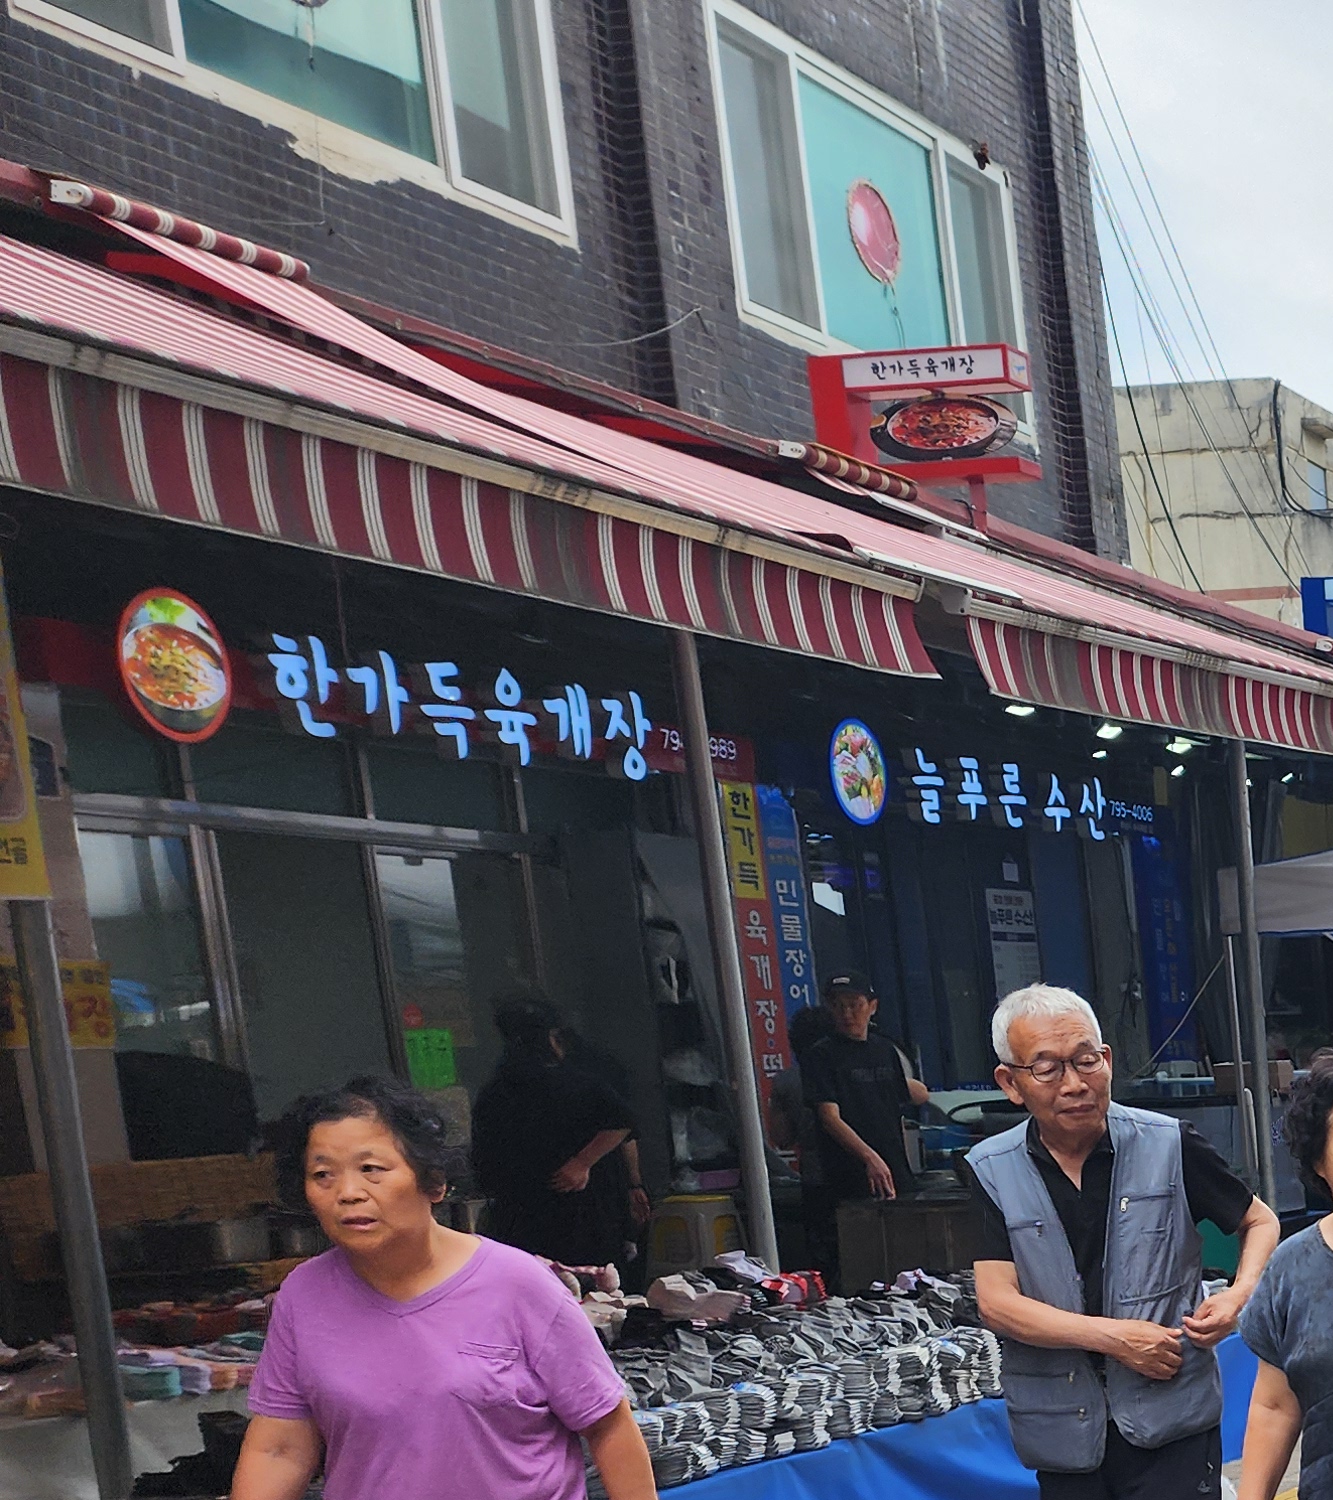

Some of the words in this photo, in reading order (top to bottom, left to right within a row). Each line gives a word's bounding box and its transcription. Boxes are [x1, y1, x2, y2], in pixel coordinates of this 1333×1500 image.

[871, 355, 975, 378] 한가득육개장
[267, 632, 653, 781] 한가득육개장
[728, 789, 761, 891] 한가득
[912, 747, 1106, 840] 늘푸른수산
[1109, 800, 1154, 823] 795-4006
